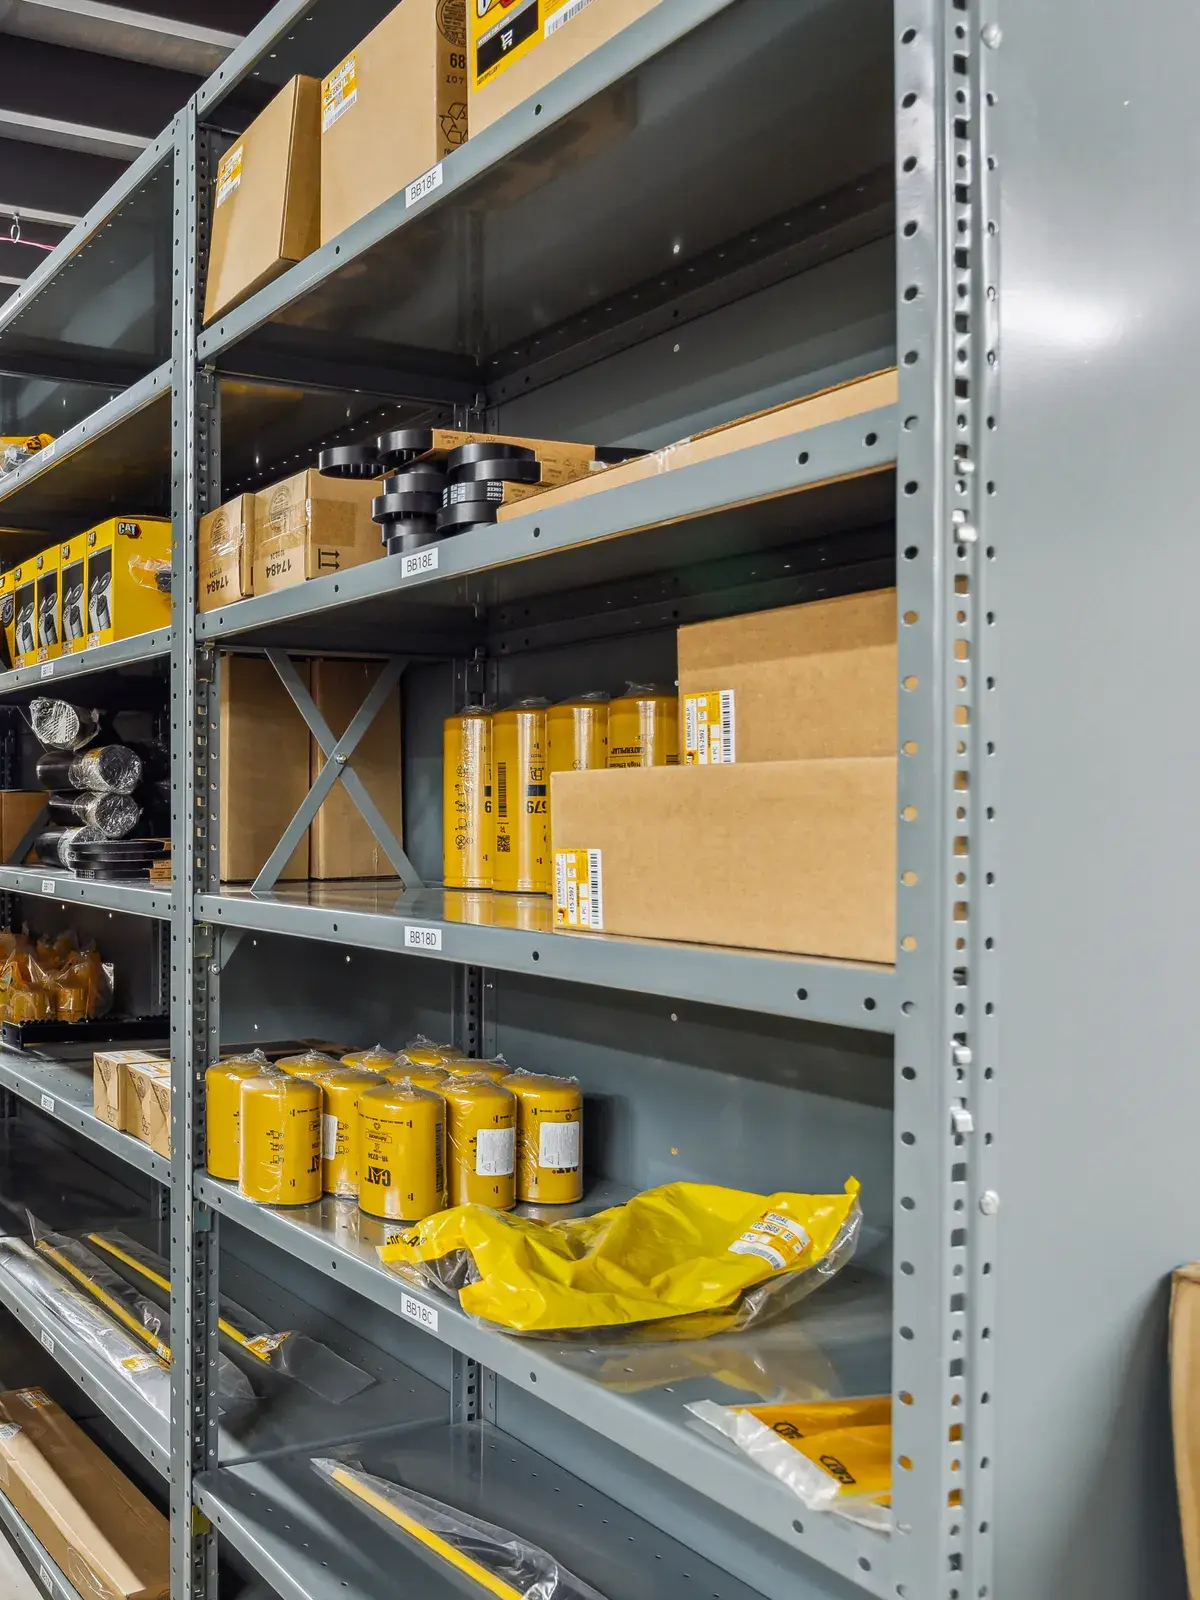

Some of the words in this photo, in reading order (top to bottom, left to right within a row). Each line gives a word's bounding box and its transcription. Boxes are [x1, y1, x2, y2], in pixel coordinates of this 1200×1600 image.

[410, 170, 437, 201] BB18F
[118, 522, 136, 536] CAT
[265, 558, 292, 578] 17484
[406, 553, 433, 573] BB18E
[206, 575, 229, 594] 17484
[409, 930, 437, 946] BB18D
[366, 1165, 392, 1187] CAT
[406, 1299, 433, 1325] BB18C
